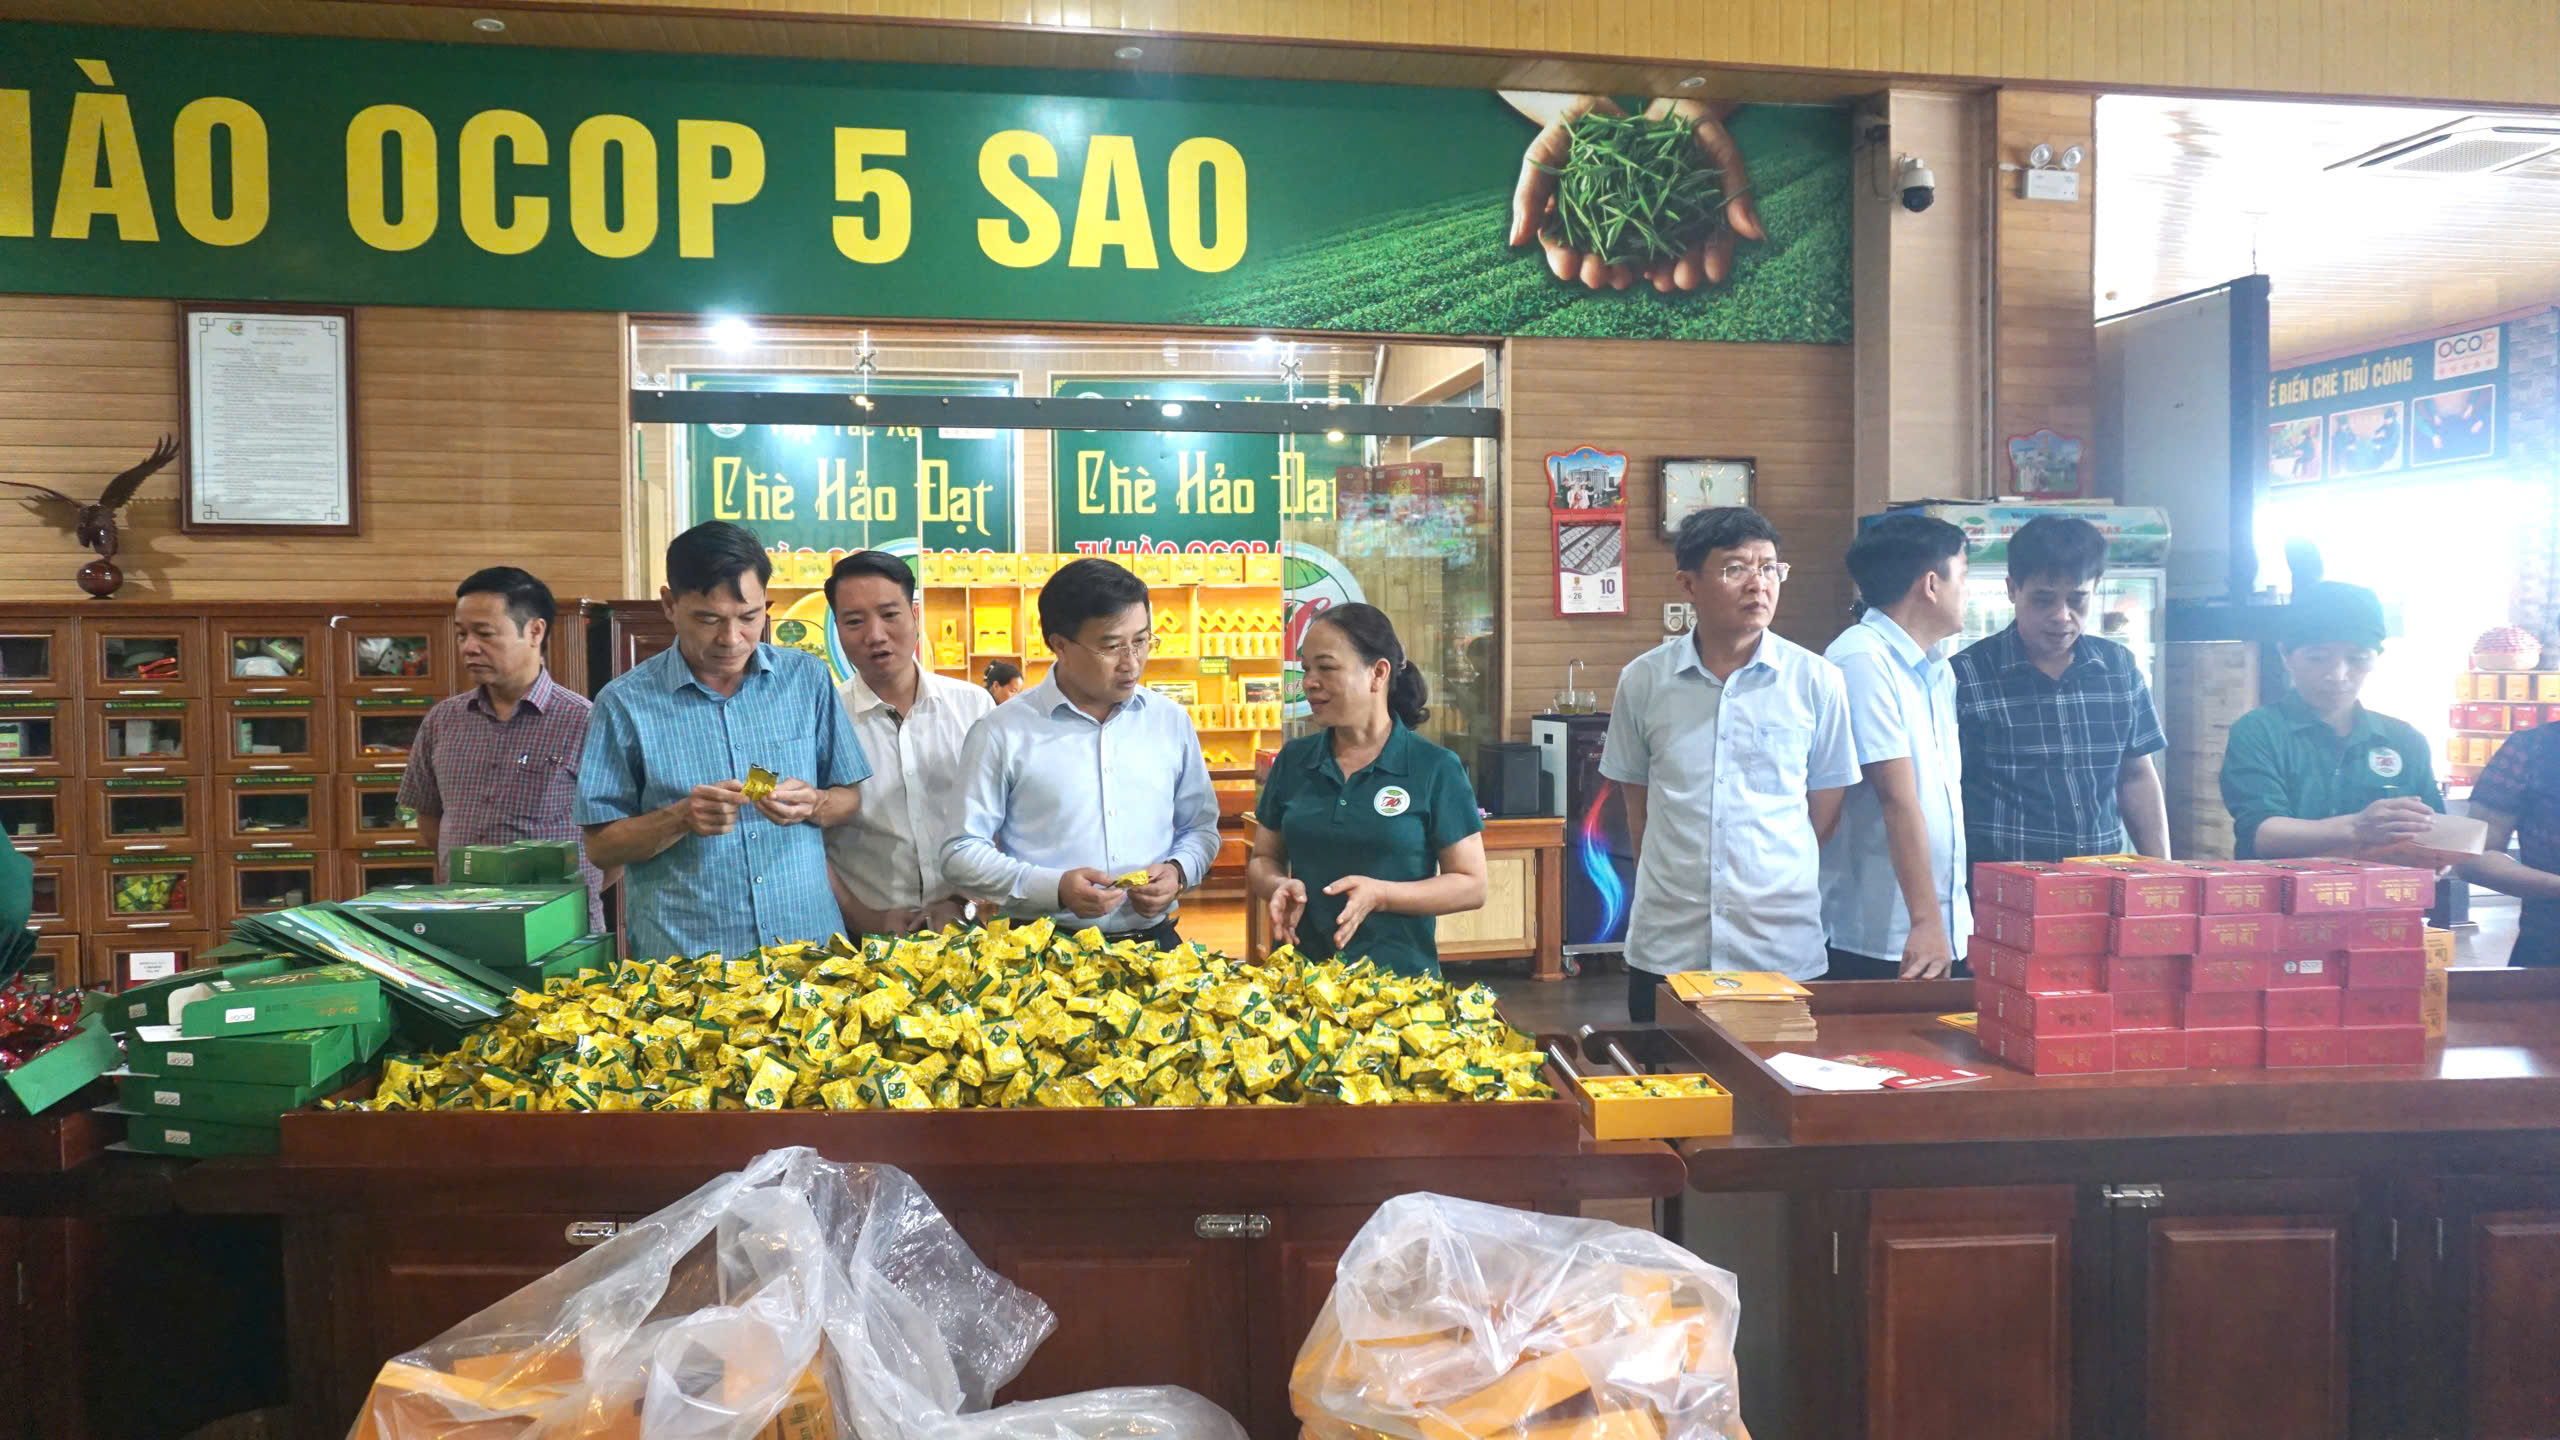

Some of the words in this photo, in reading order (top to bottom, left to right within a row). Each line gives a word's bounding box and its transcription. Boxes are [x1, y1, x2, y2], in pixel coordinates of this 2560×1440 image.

[346, 104, 766, 258] OCOP
[832, 126, 912, 264] 5
[977, 129, 1248, 272] SAO
[2438, 331, 2496, 358] OCOP
[2279, 373, 2309, 405] BIẾN
[2342, 358, 2369, 393] THỦ
[2373, 356, 2413, 387] CÔNG
[713, 457, 795, 521] Chè
[815, 458, 896, 521] Hảo
[914, 459, 994, 537] Đạt
[1077, 450, 1157, 514] Chè
[1176, 450, 1255, 514] Hảo
[1600, 578, 1615, 595] 10
